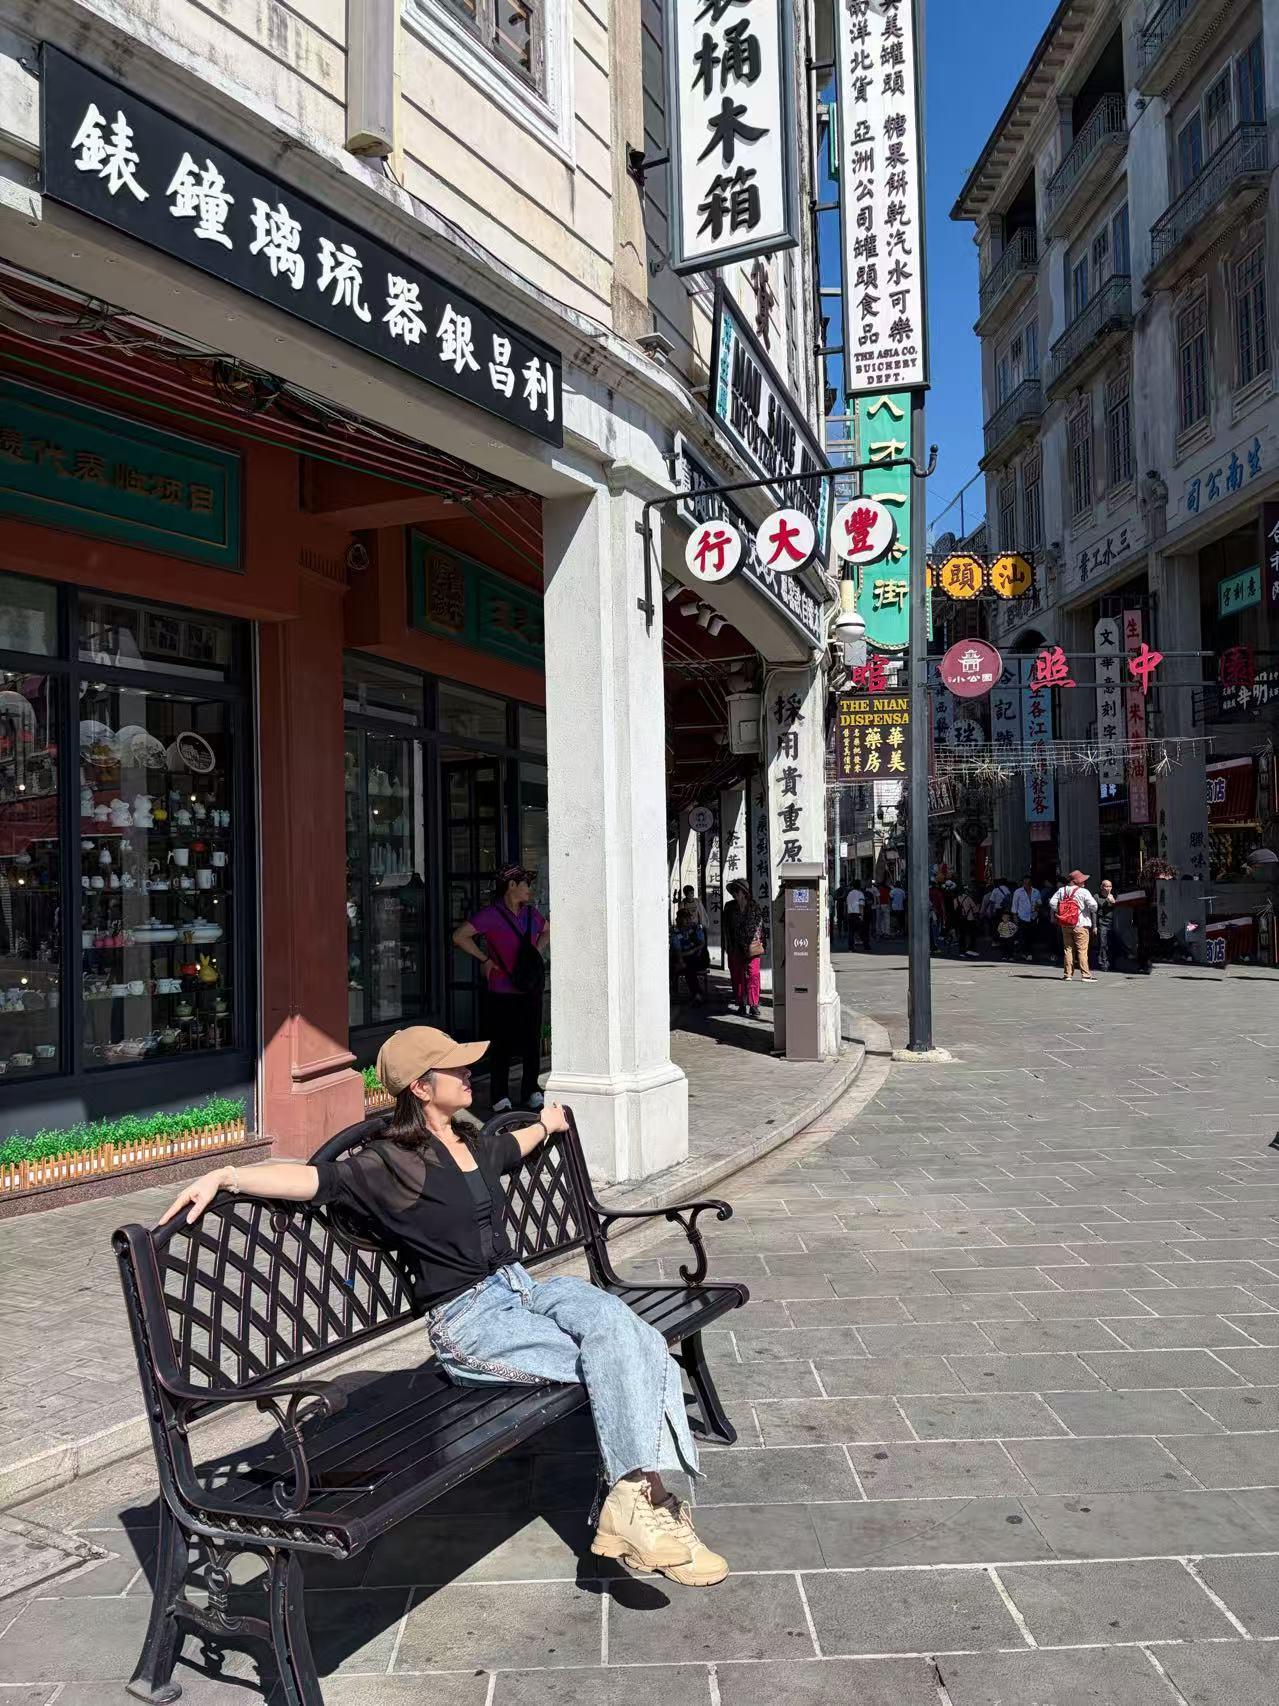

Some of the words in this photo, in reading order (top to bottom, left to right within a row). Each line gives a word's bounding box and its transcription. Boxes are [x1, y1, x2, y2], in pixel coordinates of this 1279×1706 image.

[850, 120, 881, 347] 亞洲公司罐頭食品
[854, 351, 875, 363] THE
[877, 348, 900, 360] ASIA
[901, 345, 918, 356] CO.
[867, 373, 905, 385] DEPT.
[840, 700, 869, 712] THE
[840, 714, 909, 726] DISPENSA
[864, 727, 883, 773] 藥房
[886, 727, 906, 773] 華美
